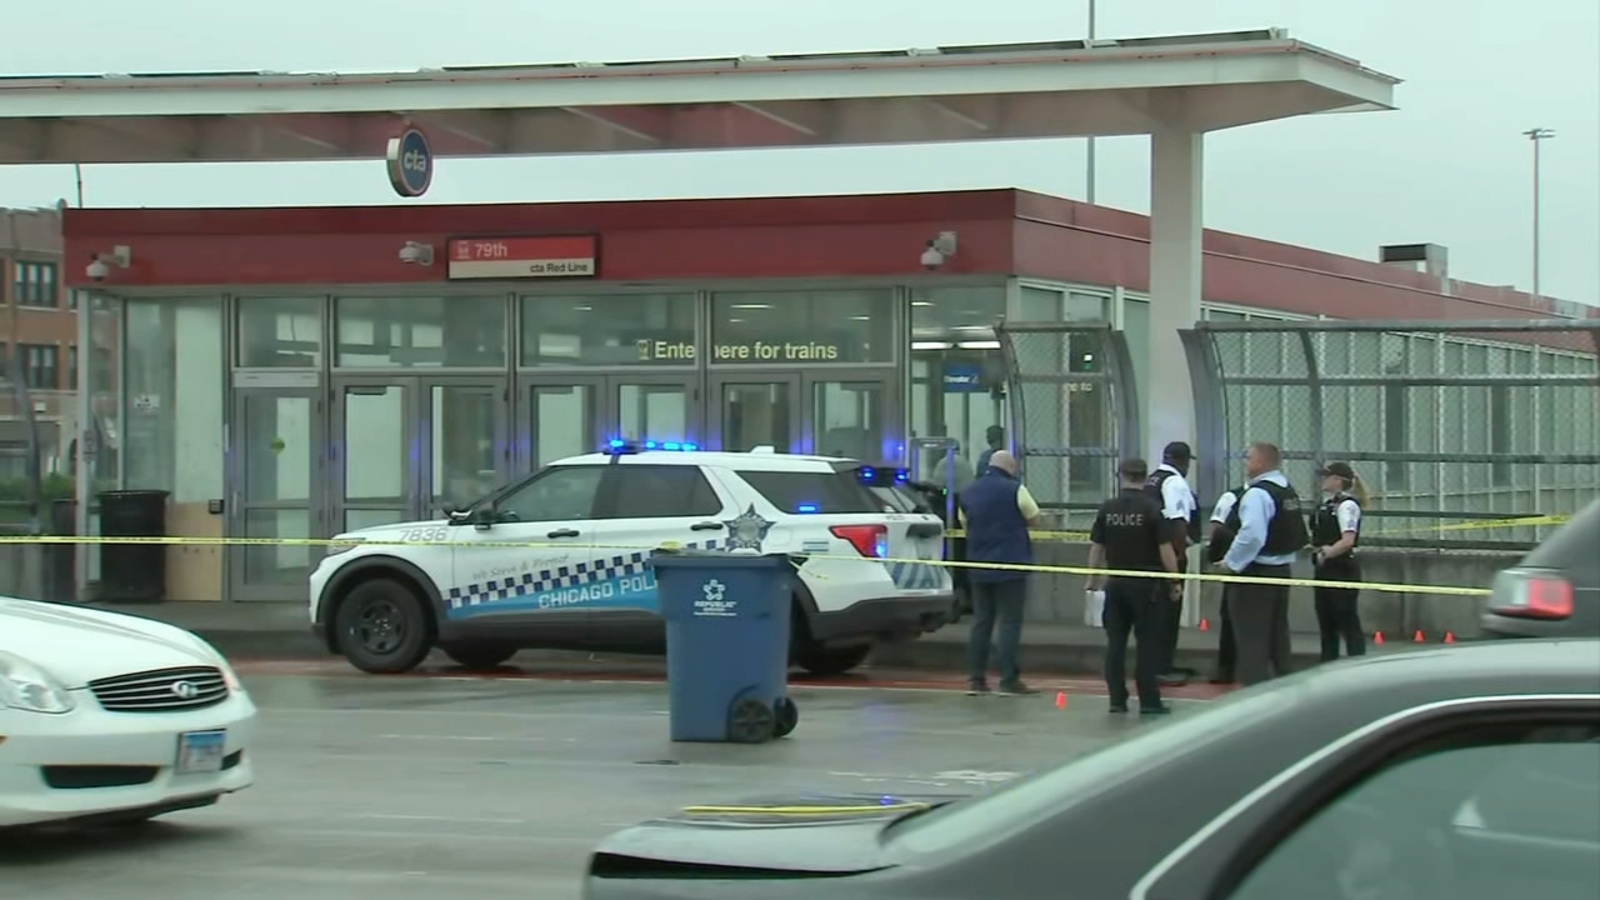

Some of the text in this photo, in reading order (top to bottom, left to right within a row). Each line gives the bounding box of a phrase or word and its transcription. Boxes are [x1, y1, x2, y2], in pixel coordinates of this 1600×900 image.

[404, 150, 426, 172] cta
[474, 242, 508, 257] 79th
[530, 261, 588, 273] cta Red Line
[654, 341, 695, 359] Ente
[754, 341, 780, 359] for
[784, 341, 838, 359] trains
[1105, 513, 1145, 526] POLICE
[400, 528, 447, 542] 7836
[539, 581, 614, 609] CHICAGO
